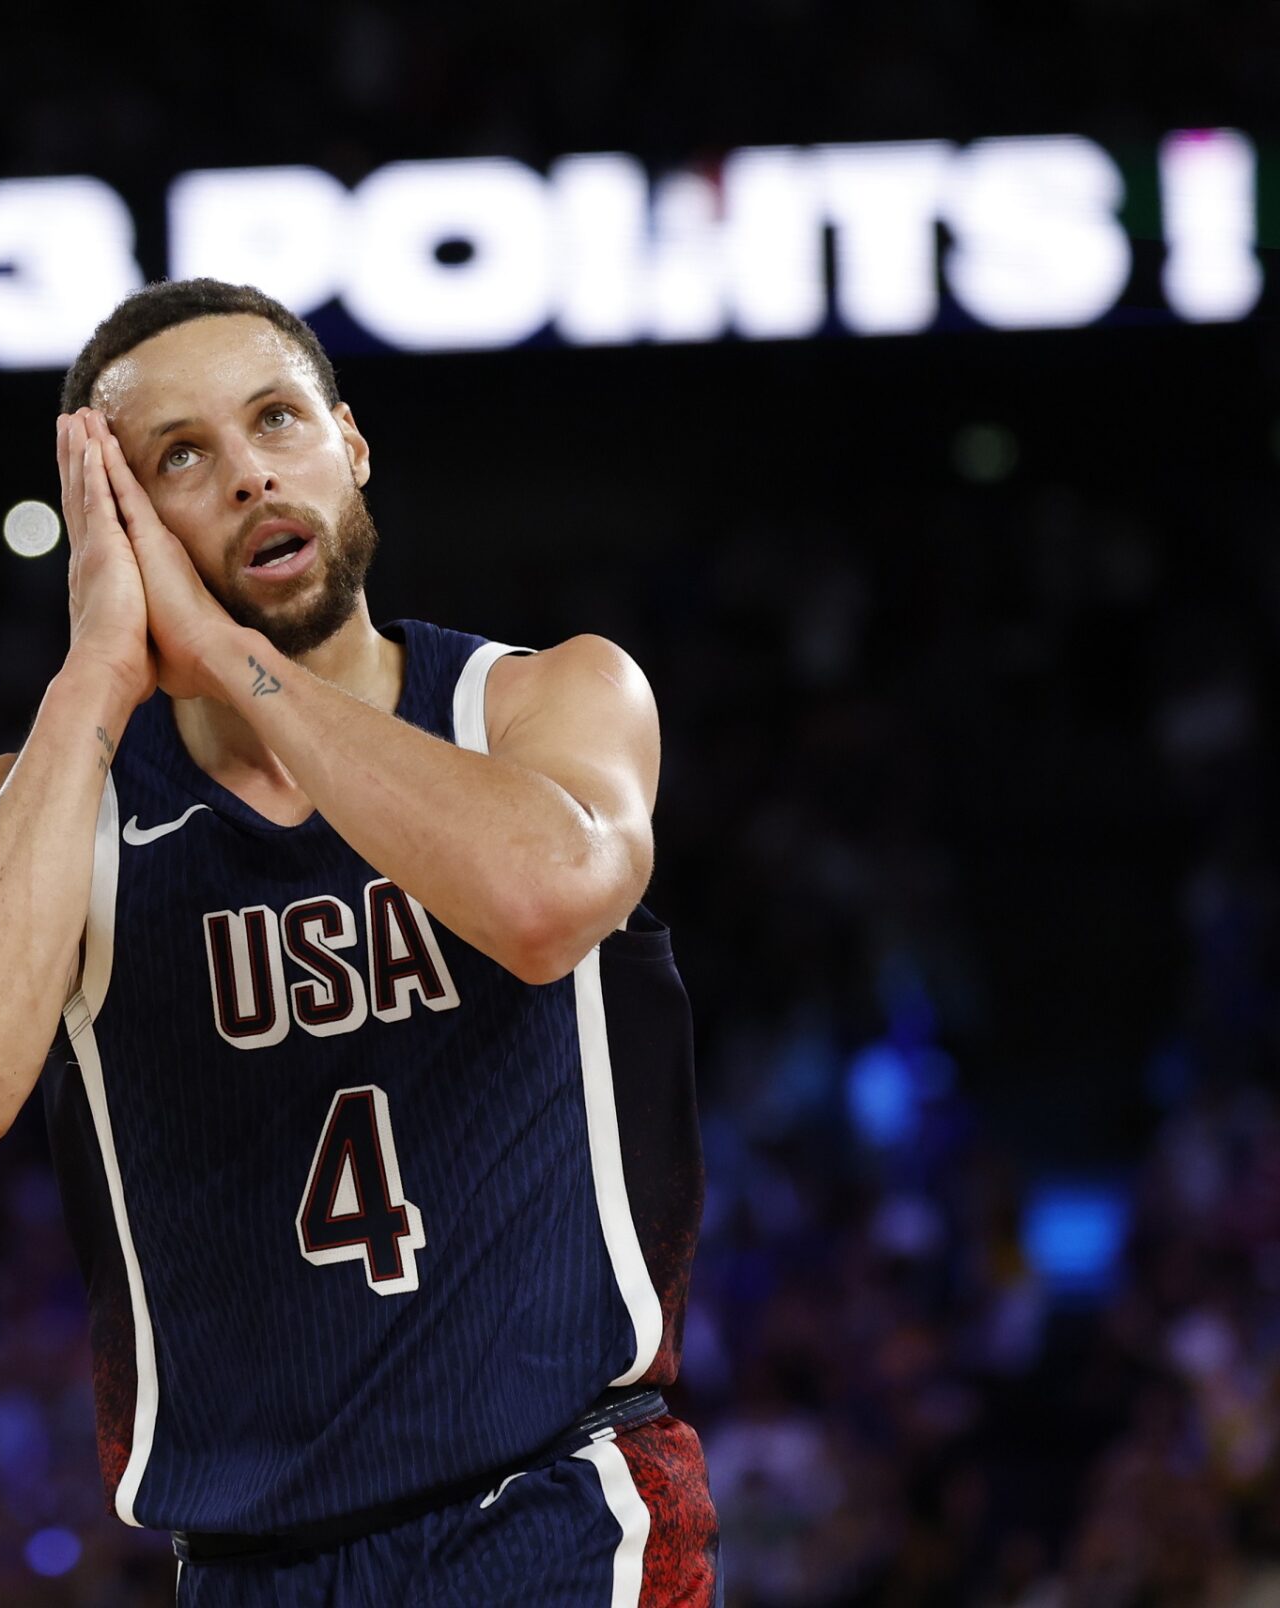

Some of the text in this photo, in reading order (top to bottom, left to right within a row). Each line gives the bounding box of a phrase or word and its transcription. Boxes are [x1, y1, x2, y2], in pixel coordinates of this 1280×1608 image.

[167, 137, 1130, 351] POINTS
[203, 877, 461, 1050] USA
[295, 1084, 426, 1296] 4
